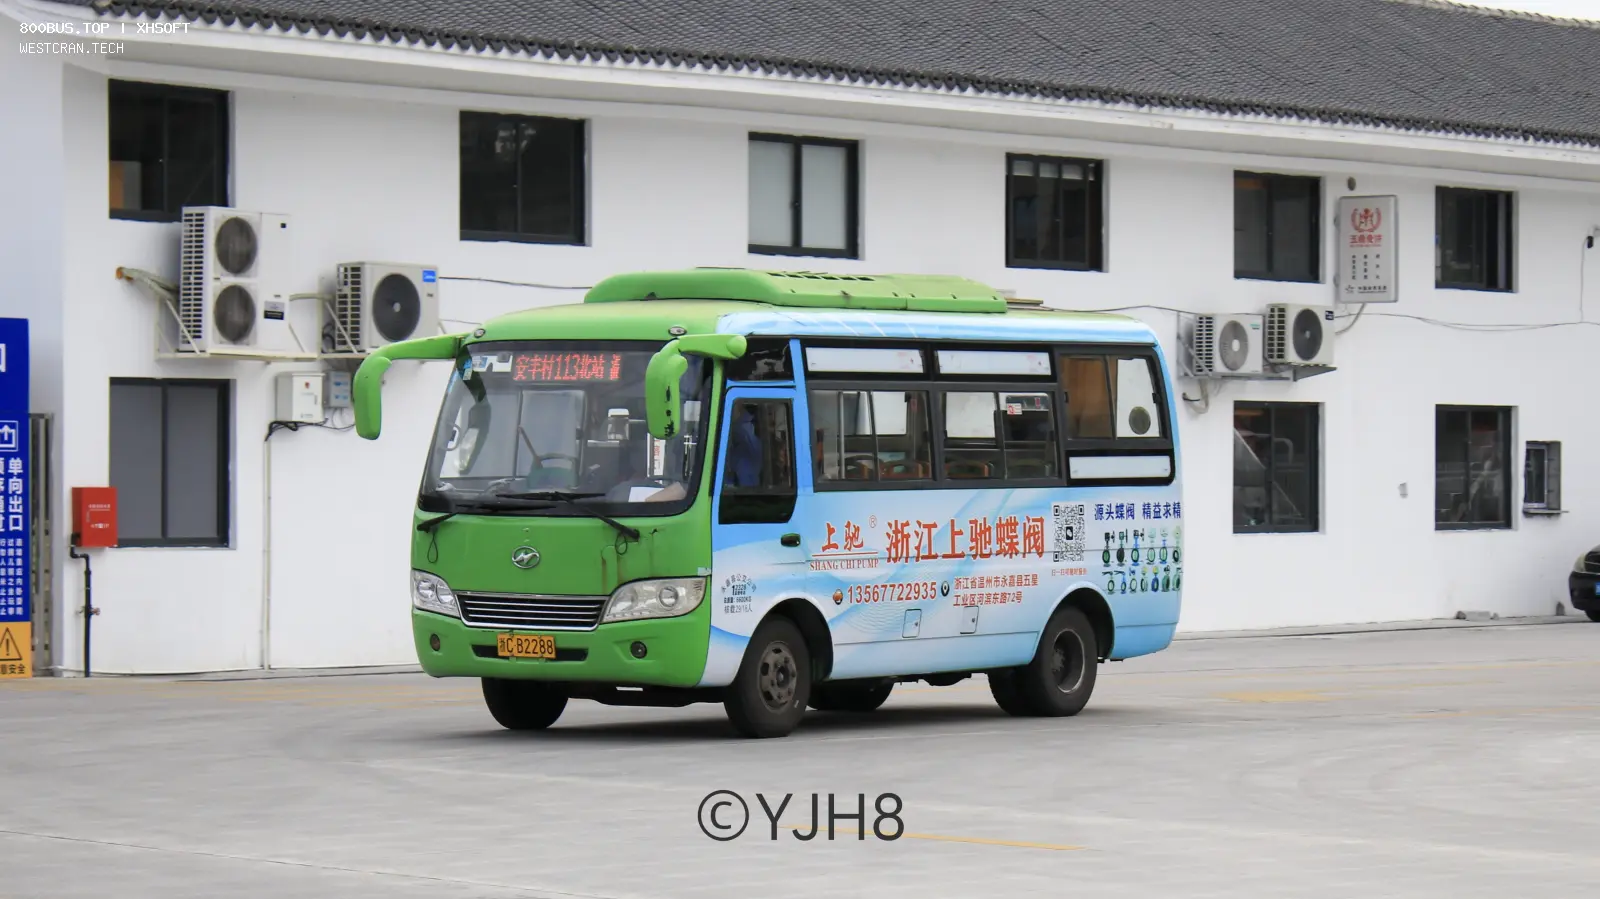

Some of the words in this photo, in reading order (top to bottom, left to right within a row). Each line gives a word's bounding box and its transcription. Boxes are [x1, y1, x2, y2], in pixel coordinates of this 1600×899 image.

[8, 457, 23, 531] 单向出口
[1094, 503, 1135, 521] 源头蝶阀
[1142, 502, 1181, 520] 精益求精
[821, 519, 864, 553] 上驰
[886, 515, 1045, 564] 浙江上驰蝶阀
[809, 560, 838, 572] SHANG
[857, 557, 879, 569] PUMP
[847, 581, 937, 604] 13567722935
